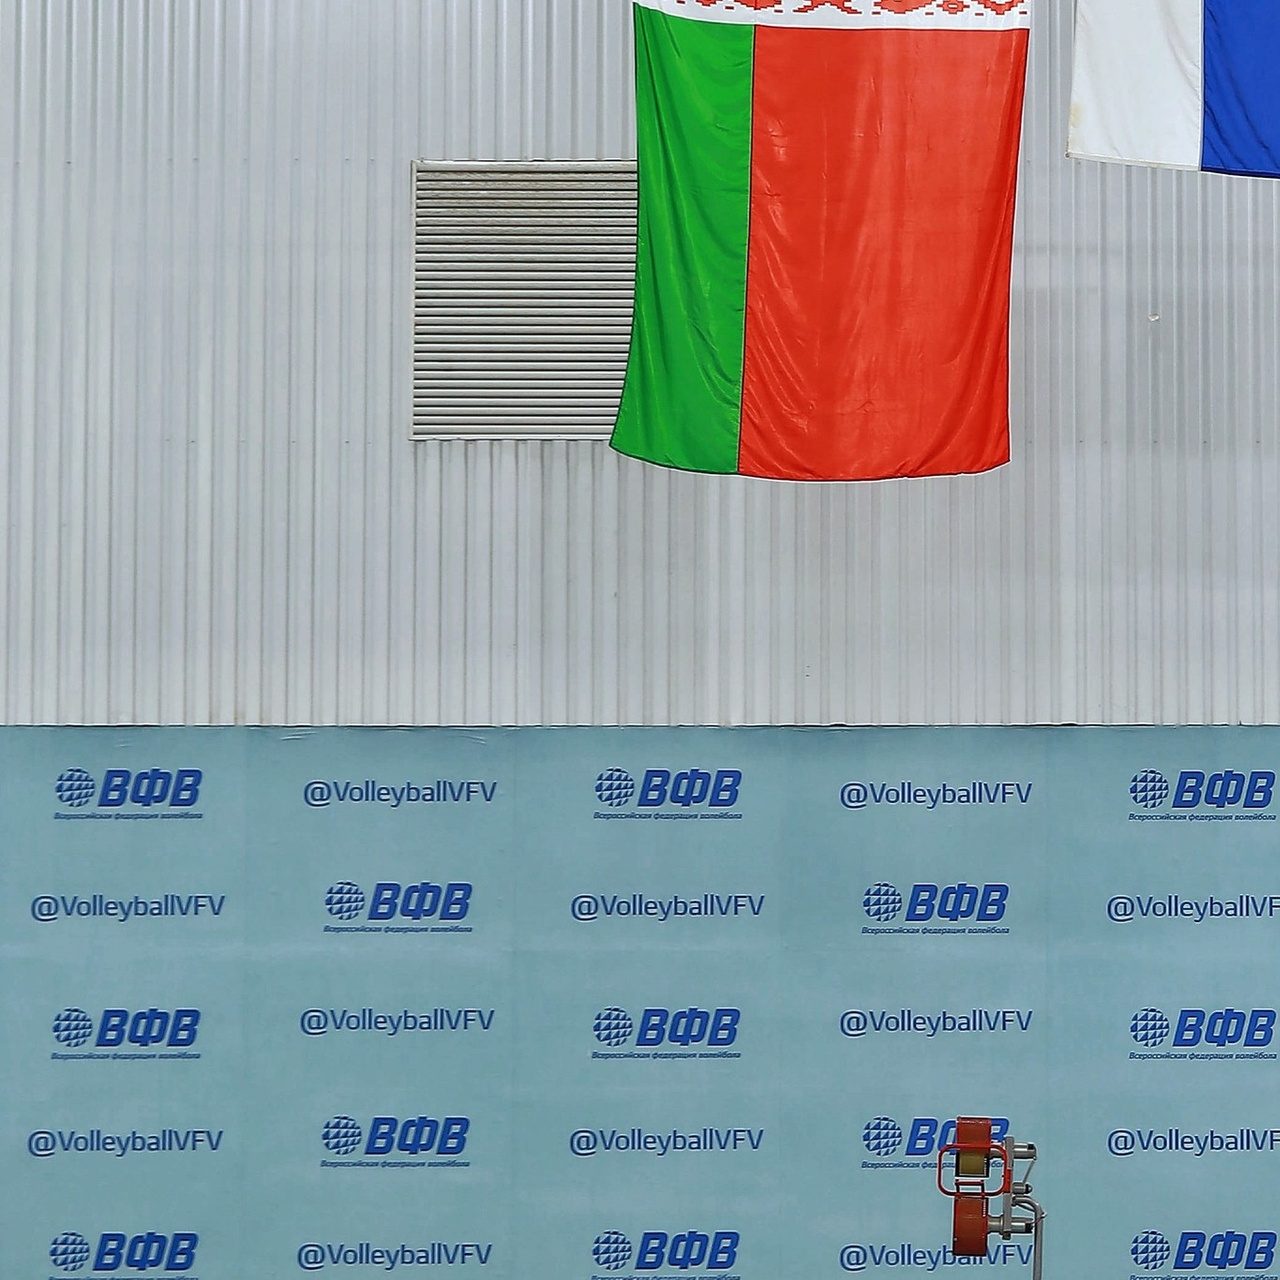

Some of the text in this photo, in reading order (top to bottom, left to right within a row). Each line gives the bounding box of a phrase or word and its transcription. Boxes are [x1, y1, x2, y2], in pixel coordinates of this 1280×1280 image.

[97, 768, 203, 807] ВФВ
[304, 780, 497, 807] @VolleyballVFV
[637, 768, 743, 807] ВФВ
[841, 782, 1032, 810] @VolleyballVFV
[1172, 769, 1276, 808] ВФВ
[31, 894, 225, 922] @VolleyballVFV
[367, 881, 474, 920] ВФВ
[571, 894, 765, 921] @VolleyballVFV
[905, 882, 1010, 922] ВФВ
[95, 1007, 202, 1047] ВФВ
[301, 1009, 495, 1036] @VolleyballVFV
[635, 1007, 742, 1046] ВФВ
[840, 1010, 1032, 1037] @VolleyballVFV
[1172, 1006, 1277, 1047] ВФВ
[28, 1129, 223, 1157] @VolleyballVFV
[364, 1115, 471, 1155] ВФВ
[570, 1128, 764, 1156] @VolleyballVFV
[92, 1231, 200, 1271] ВФВ
[297, 1243, 492, 1270] @VolleyballVFV
[634, 1230, 741, 1270] ВФВ
[1173, 1230, 1278, 1270] ВФВ
